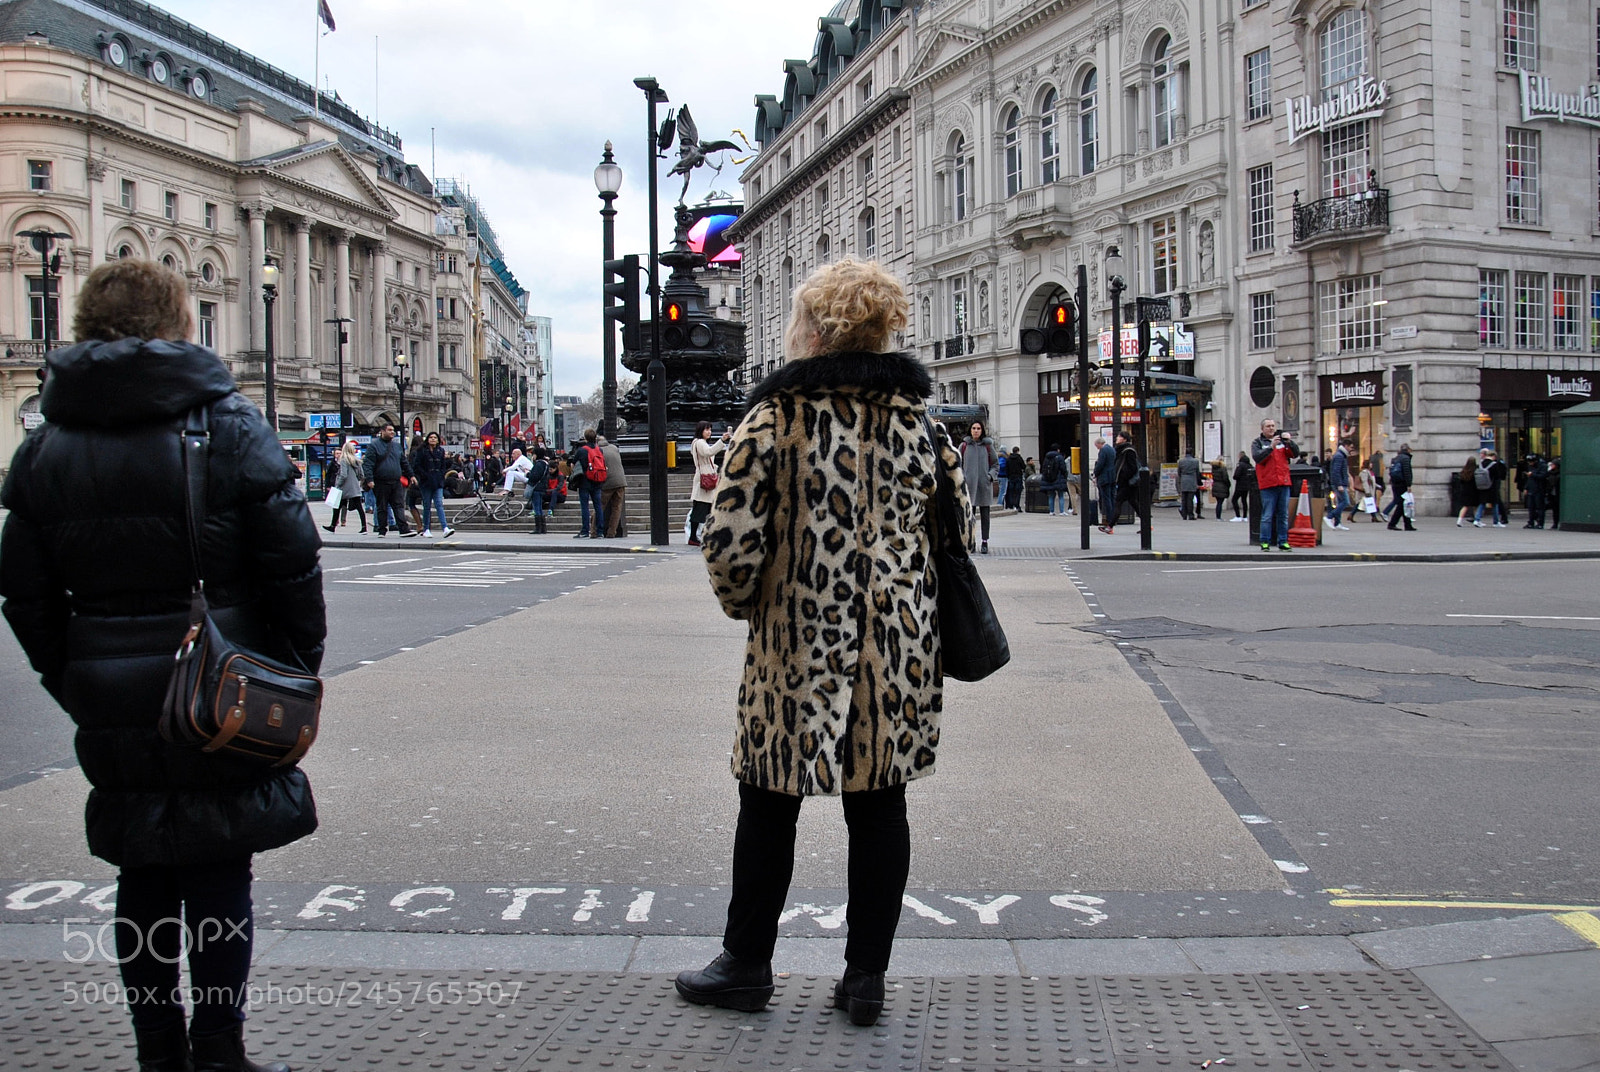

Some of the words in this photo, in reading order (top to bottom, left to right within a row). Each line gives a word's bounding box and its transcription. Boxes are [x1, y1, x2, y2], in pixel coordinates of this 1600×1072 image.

[1519, 68, 1600, 126] Lillywhi
[1285, 75, 1388, 146] Lillywhites
[1175, 345, 1193, 354] BANK
[1331, 380, 1376, 403] Lillywhites
[1547, 374, 1592, 397] Lillywhites
